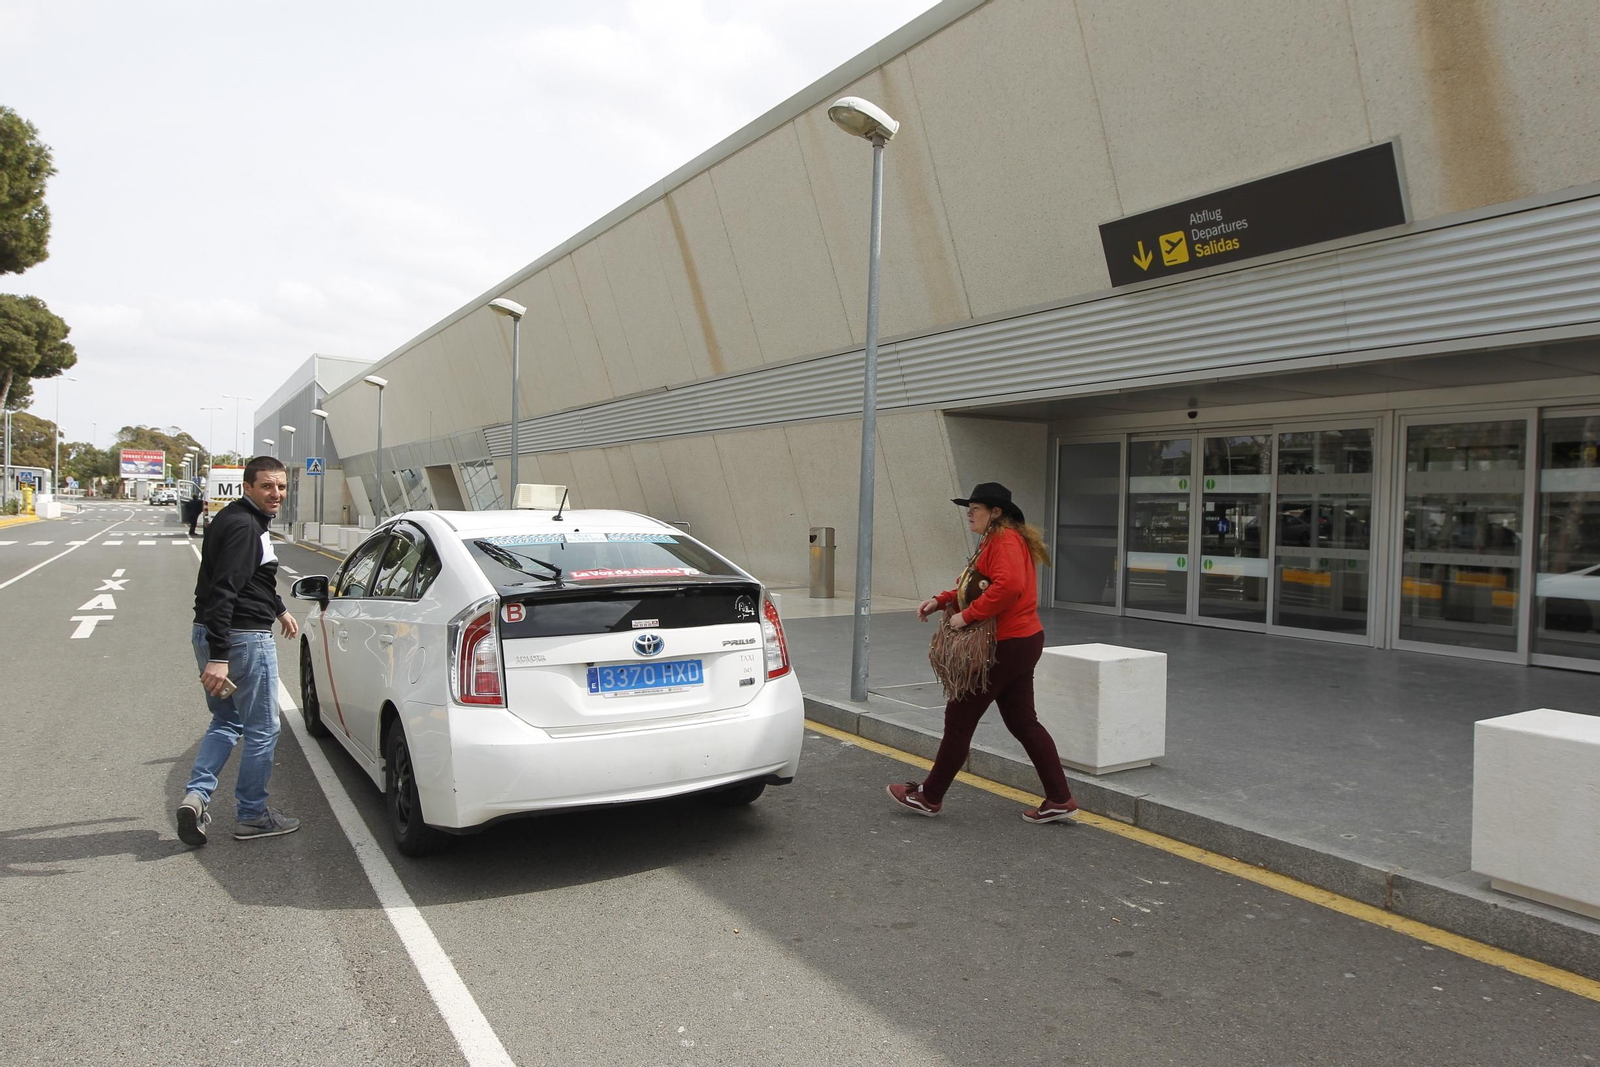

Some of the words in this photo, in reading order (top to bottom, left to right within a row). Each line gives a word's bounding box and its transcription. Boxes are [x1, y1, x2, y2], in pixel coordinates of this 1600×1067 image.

[1190, 209, 1223, 225] Abflug
[1192, 219, 1248, 240] Departures
[1195, 238, 1240, 257] Salidas
[218, 483, 242, 495] M1
[70, 569, 130, 638] TAXI
[507, 604, 523, 621] B
[722, 638, 756, 646] PRIUS
[516, 655, 547, 663] TOYOTA
[603, 666, 656, 689] 3370
[662, 662, 700, 684] HXD
